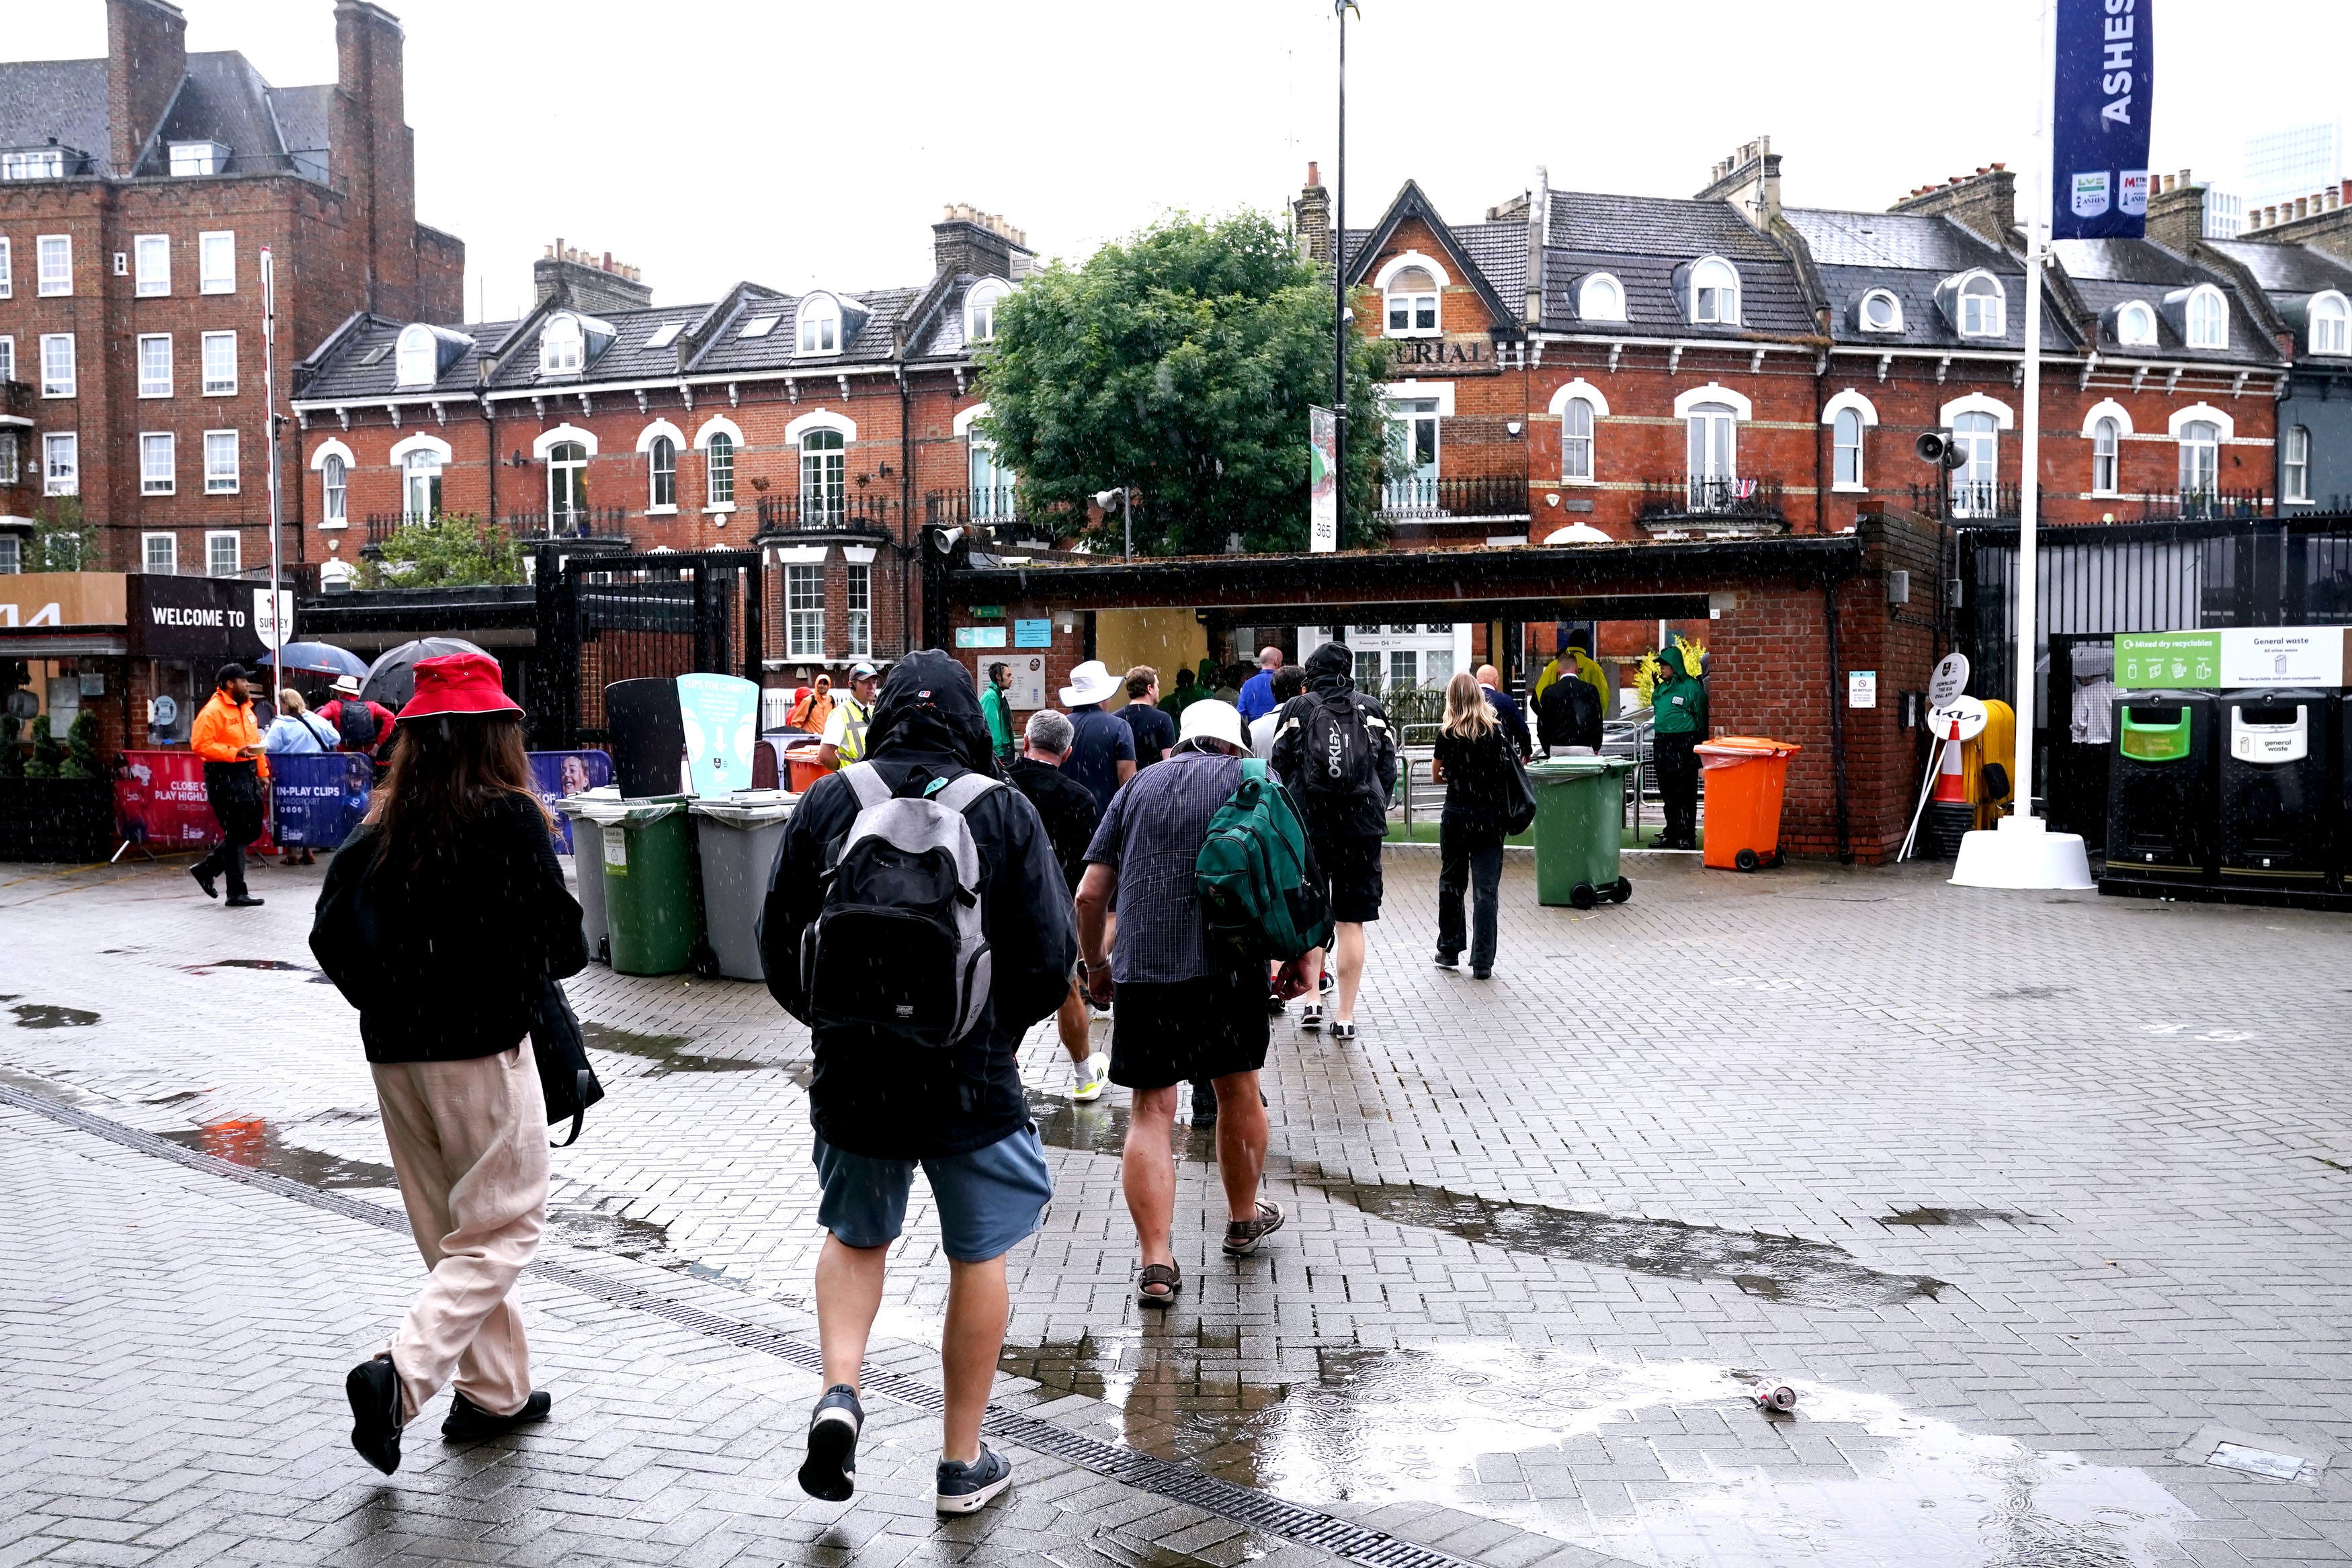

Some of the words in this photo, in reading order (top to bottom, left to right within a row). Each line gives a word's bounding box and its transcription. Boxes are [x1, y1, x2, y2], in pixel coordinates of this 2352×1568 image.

[2102, 0, 2134, 124] ASHES
[1316, 523, 1331, 538] 365
[152, 607, 223, 627] WELCOME
[227, 610, 245, 627] TO
[259, 617, 288, 629] SUREY
[2158, 640, 2171, 649] dry
[2172, 640, 2212, 649] recyclables
[683, 679, 704, 689] CUPS
[704, 680, 719, 691] FOR
[720, 682, 752, 694] CHARITY
[1936, 679, 1958, 687] DOWNLOAD
[2265, 739, 2292, 747] general
[1328, 727, 1342, 779] OAKLEY
[171, 781, 199, 791] CLOSE
[276, 787, 311, 796] IN-PLAY
[313, 787, 340, 797] CLIPS
[155, 791, 177, 800] PLAY
[827, 1385, 854, 1398] FILA
